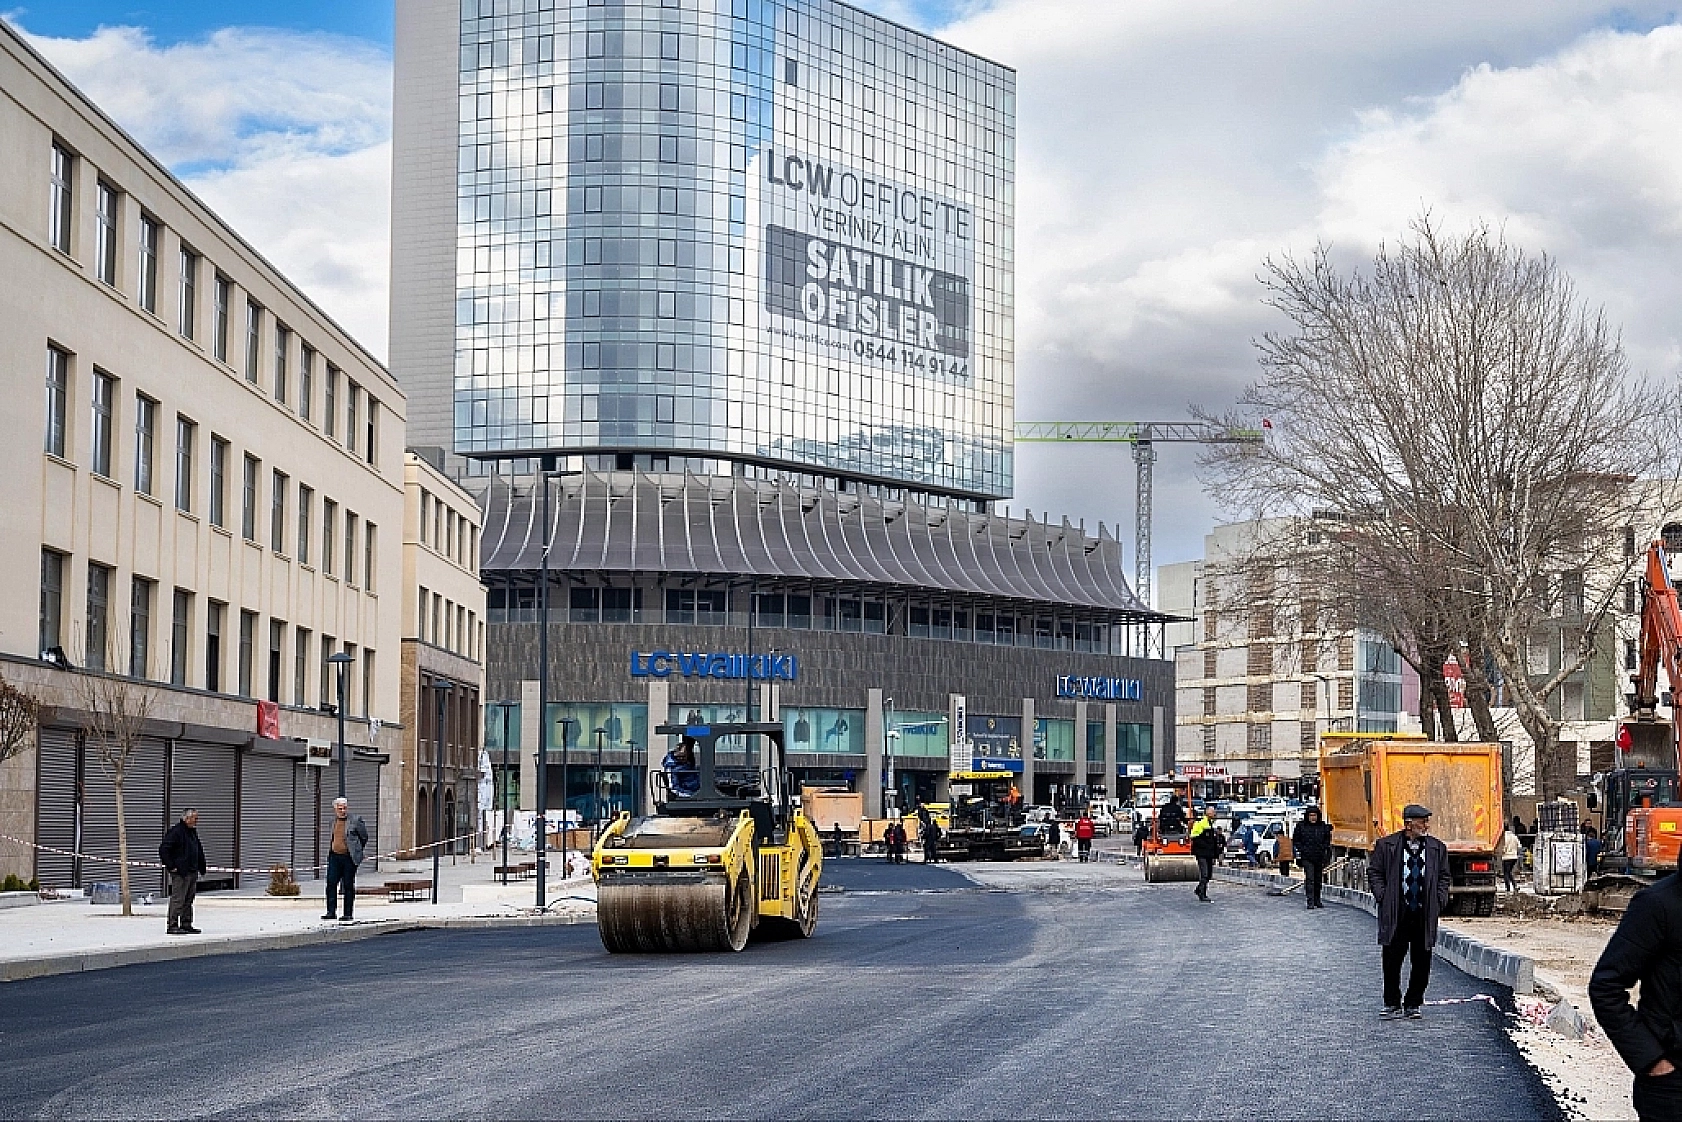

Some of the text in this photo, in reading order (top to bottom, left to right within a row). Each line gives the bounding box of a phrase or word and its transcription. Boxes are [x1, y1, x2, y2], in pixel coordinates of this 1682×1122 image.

[768, 149, 970, 241] LCW OFFICE'TE
[806, 239, 935, 308] SATILIK
[854, 340, 897, 366] 0544
[631, 650, 671, 677] LC
